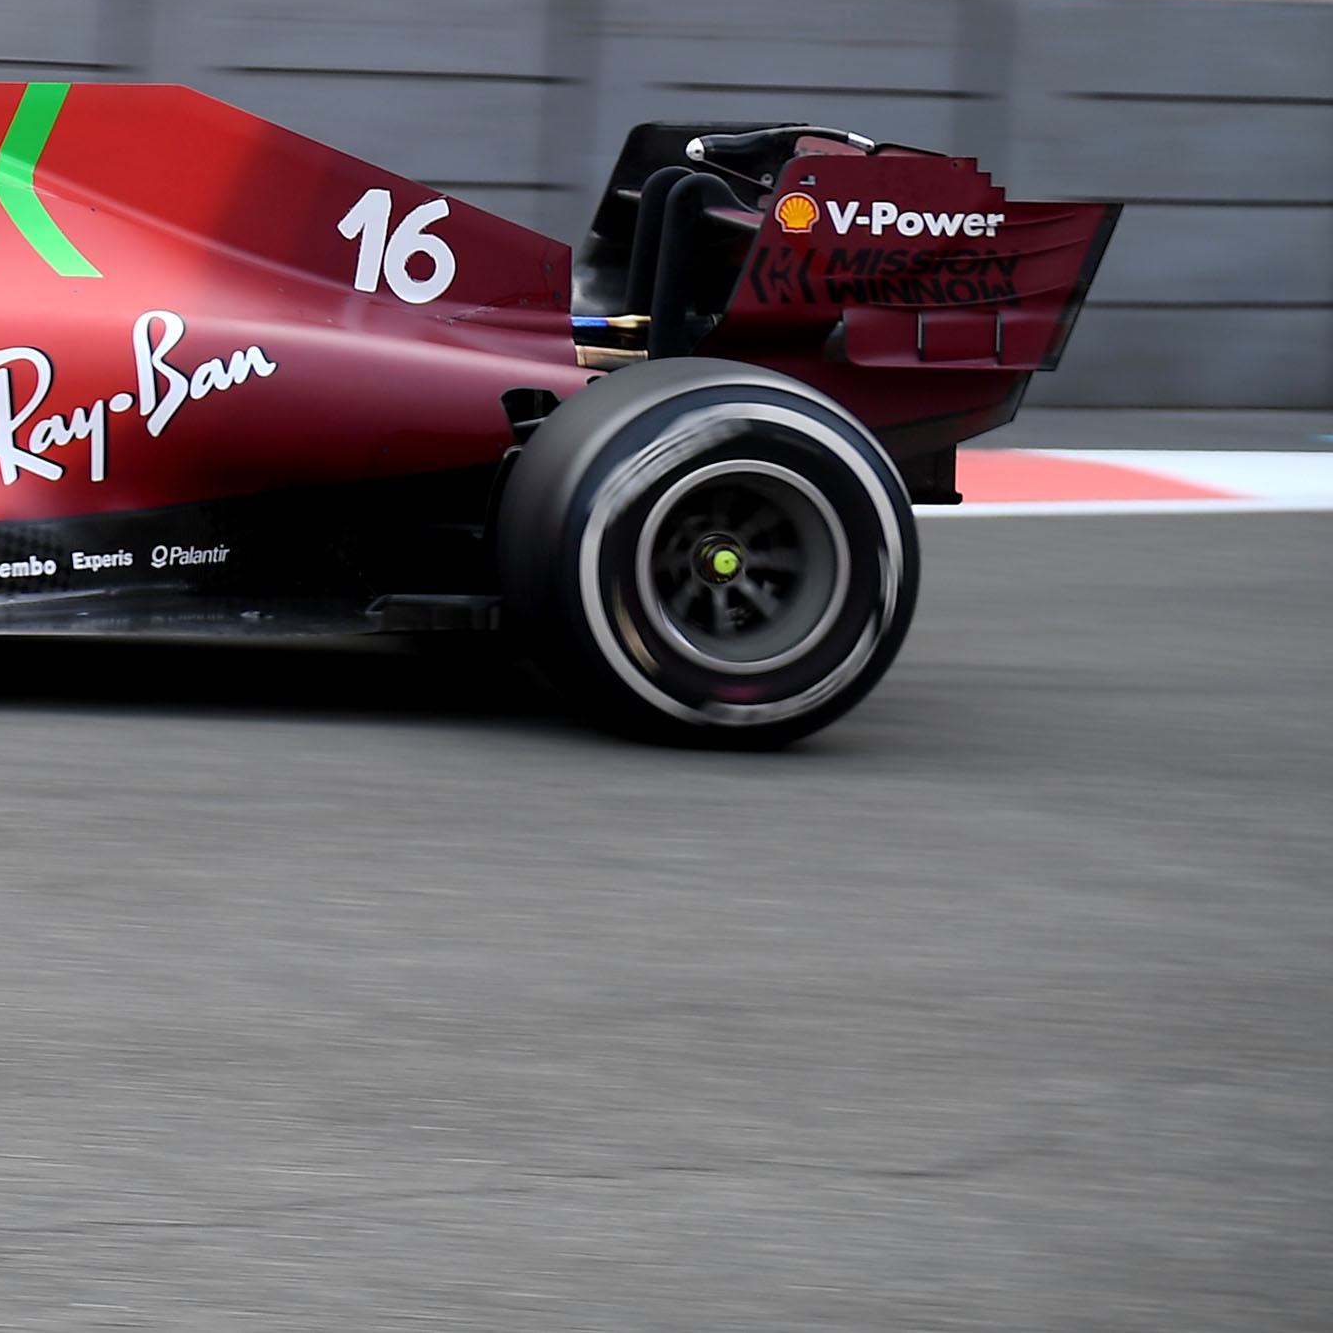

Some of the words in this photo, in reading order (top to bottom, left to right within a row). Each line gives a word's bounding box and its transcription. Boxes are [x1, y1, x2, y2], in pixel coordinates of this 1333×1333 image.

[826, 200, 1006, 237] V-Power
[337, 188, 456, 304] 16
[827, 247, 1020, 277] MISSION
[72, 548, 133, 572] Experis
[168, 543, 230, 566] Palantir
